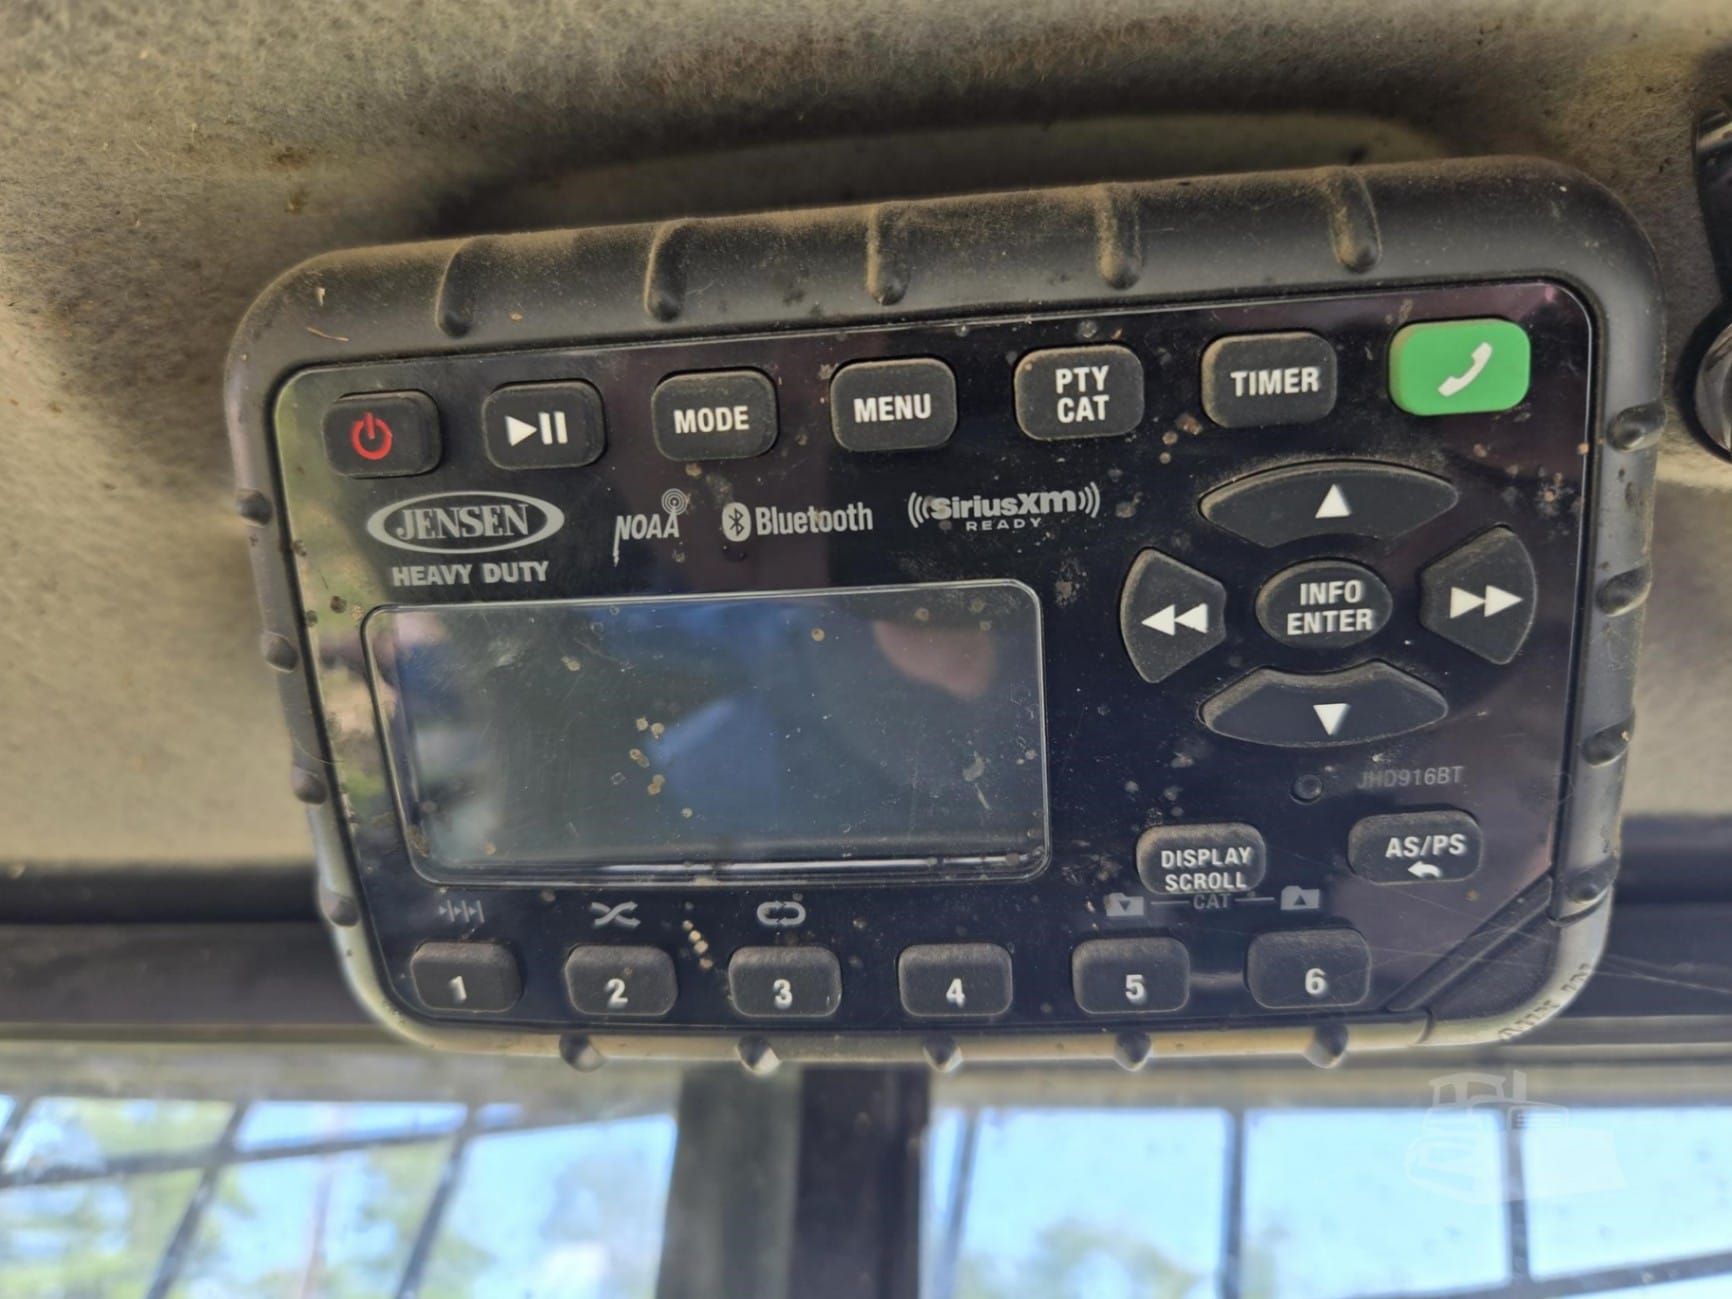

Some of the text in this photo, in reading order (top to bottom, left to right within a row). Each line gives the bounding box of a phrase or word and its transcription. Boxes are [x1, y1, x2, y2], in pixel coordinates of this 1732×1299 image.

[1055, 366, 1110, 395] PTY
[1230, 366, 1321, 398] TIMER
[673, 405, 750, 434] MODE
[853, 393, 931, 424] MENU
[1057, 395, 1110, 424] CAT
[396, 503, 530, 541] JENSEN
[756, 503, 874, 537] Bluetooth
[965, 518, 1042, 532] READY
[612, 512, 680, 562] NOAA
[391, 561, 550, 587] HEAVY DUTY
[1299, 580, 1361, 607] INFO
[1286, 608, 1374, 637] ENTER
[1357, 766, 1464, 790] JHD916BT
[1160, 846, 1253, 870] DISPLAY
[1385, 834, 1468, 860] AS/PS
[1164, 872, 1248, 893] SCROLL
[1192, 893, 1233, 911] CAT
[449, 976, 467, 1002] 1
[606, 978, 627, 1004] 2
[772, 979, 794, 1007] 3
[944, 978, 966, 1004] 4
[1124, 973, 1148, 1002] 5
[1304, 967, 1328, 996] 6
